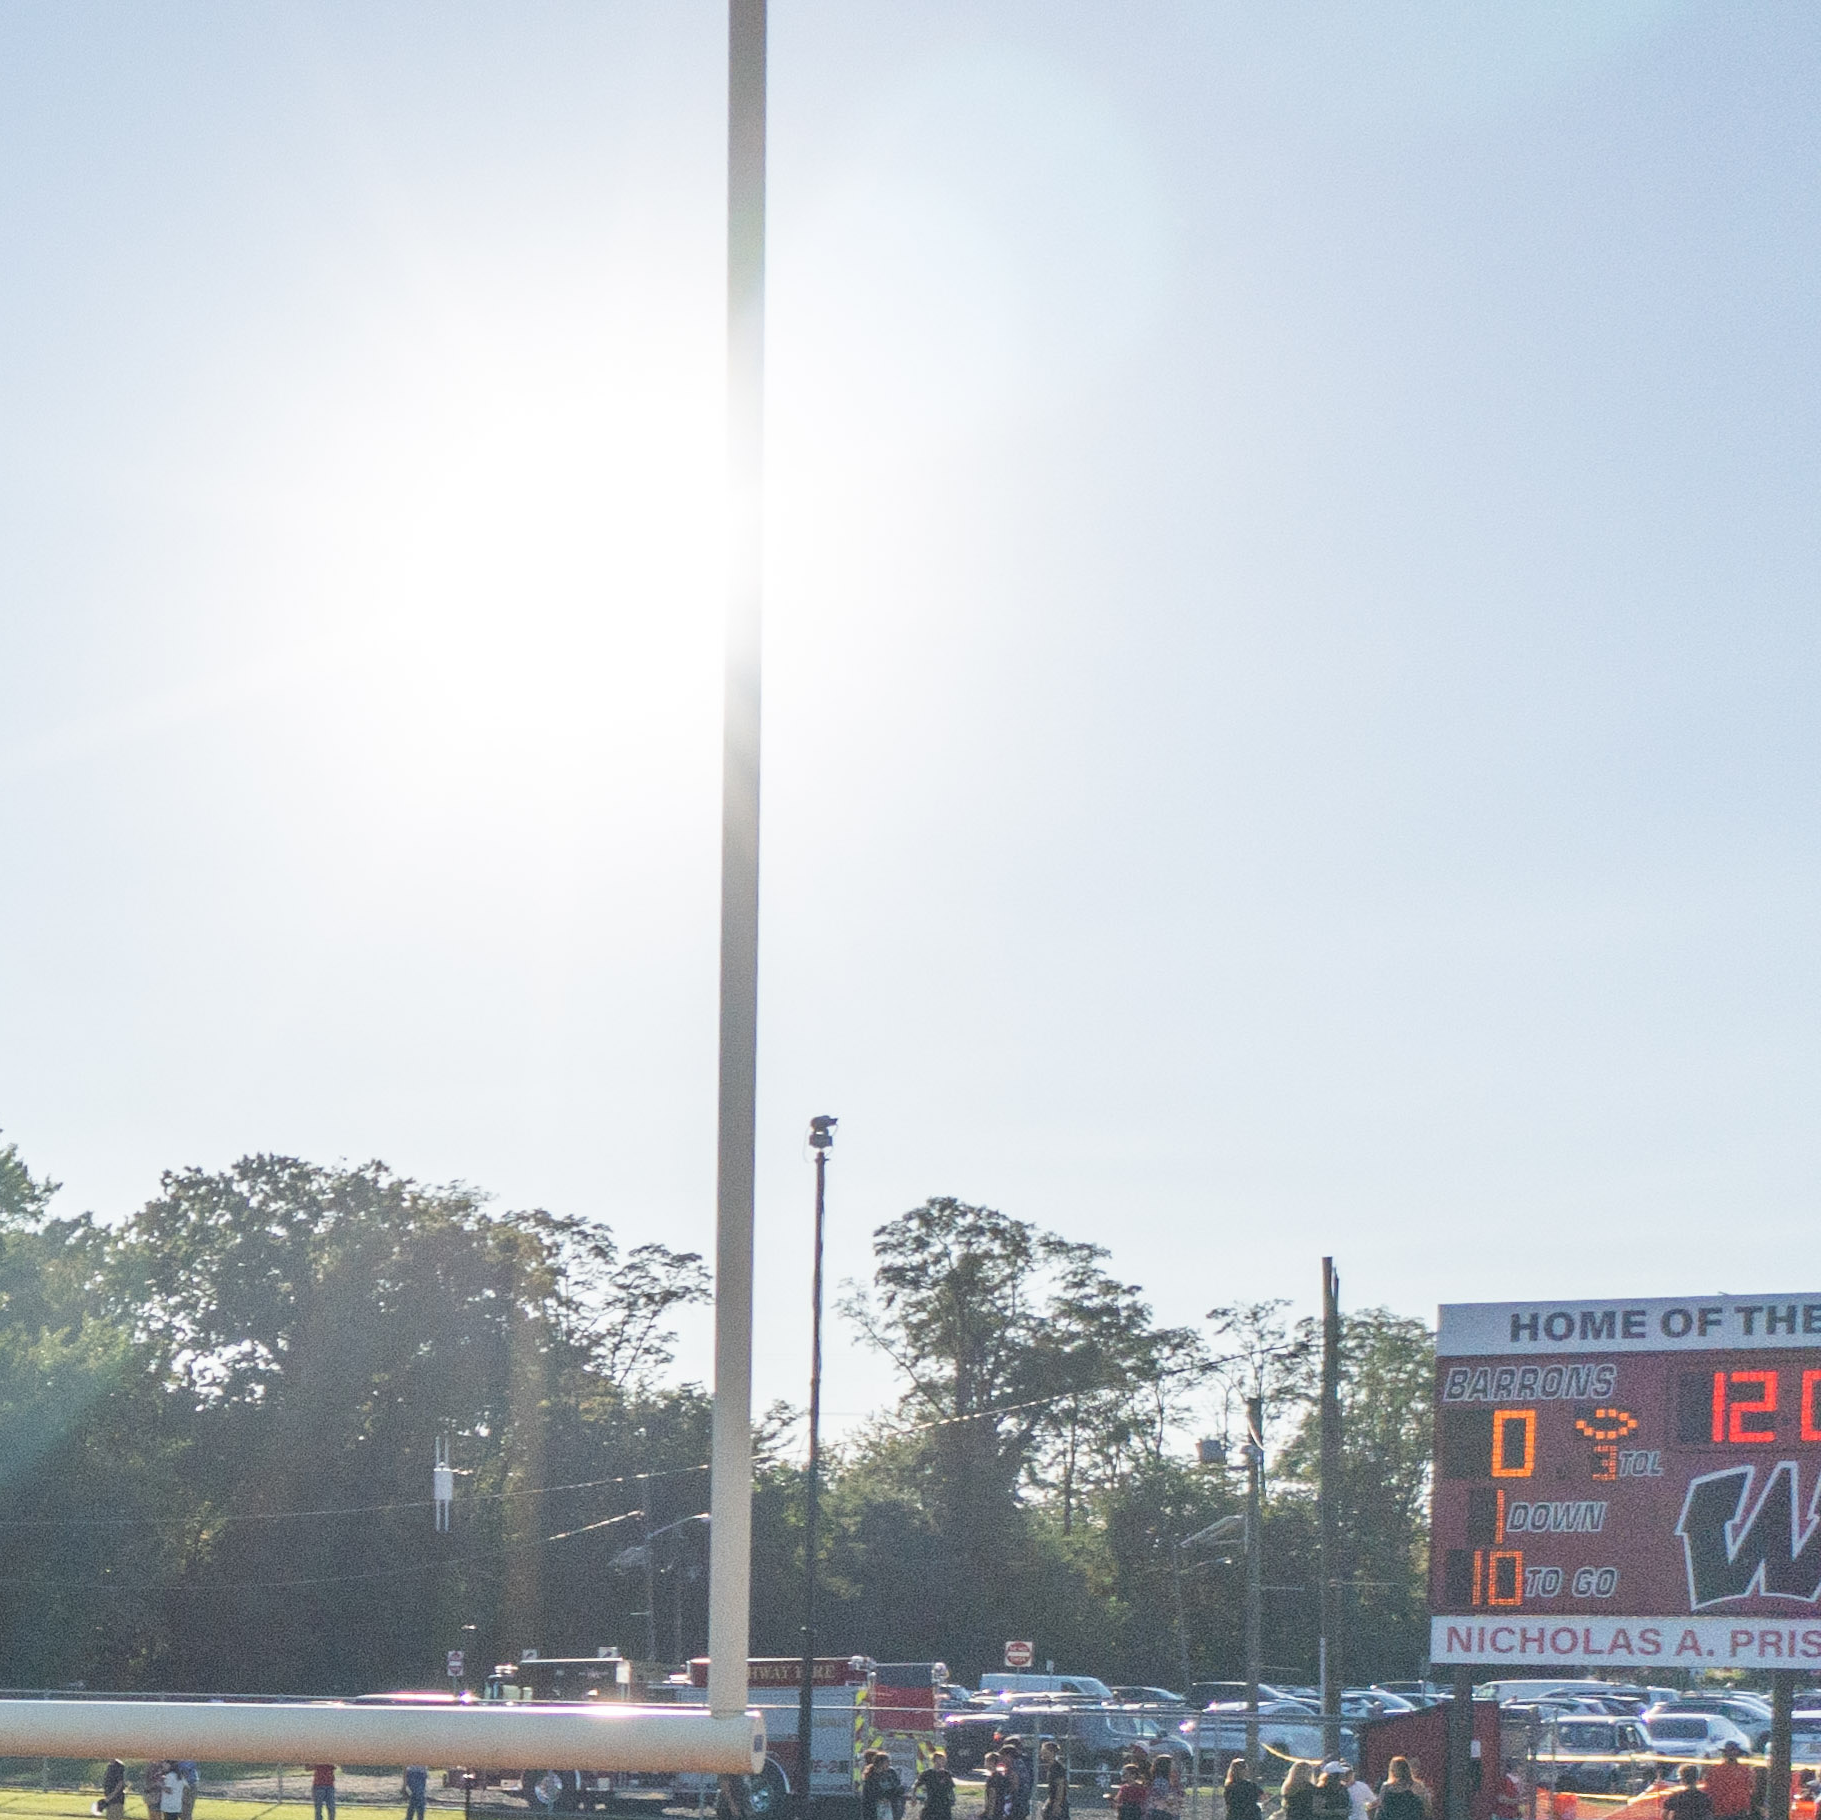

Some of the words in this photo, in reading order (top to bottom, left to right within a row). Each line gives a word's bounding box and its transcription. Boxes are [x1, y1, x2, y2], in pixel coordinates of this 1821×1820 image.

[1510, 1310, 1647, 1342] HOME
[1661, 1307, 1723, 1338] OF
[1736, 1304, 1821, 1335] THE
[1443, 1364, 1617, 1402] BARRONS
[1491, 1409, 1537, 1478] 0
[1592, 1445, 1618, 1481] 3
[1618, 1451, 1664, 1477] TOL
[1494, 1489, 1506, 1544] 1
[1506, 1502, 1606, 1533] DOWN
[1471, 1550, 1524, 1606] 10
[1524, 1566, 1563, 1597] TO
[1572, 1567, 1618, 1597] GO
[1446, 1626, 1663, 1657] NICHOLAS
[1675, 1629, 1715, 1658] A.
